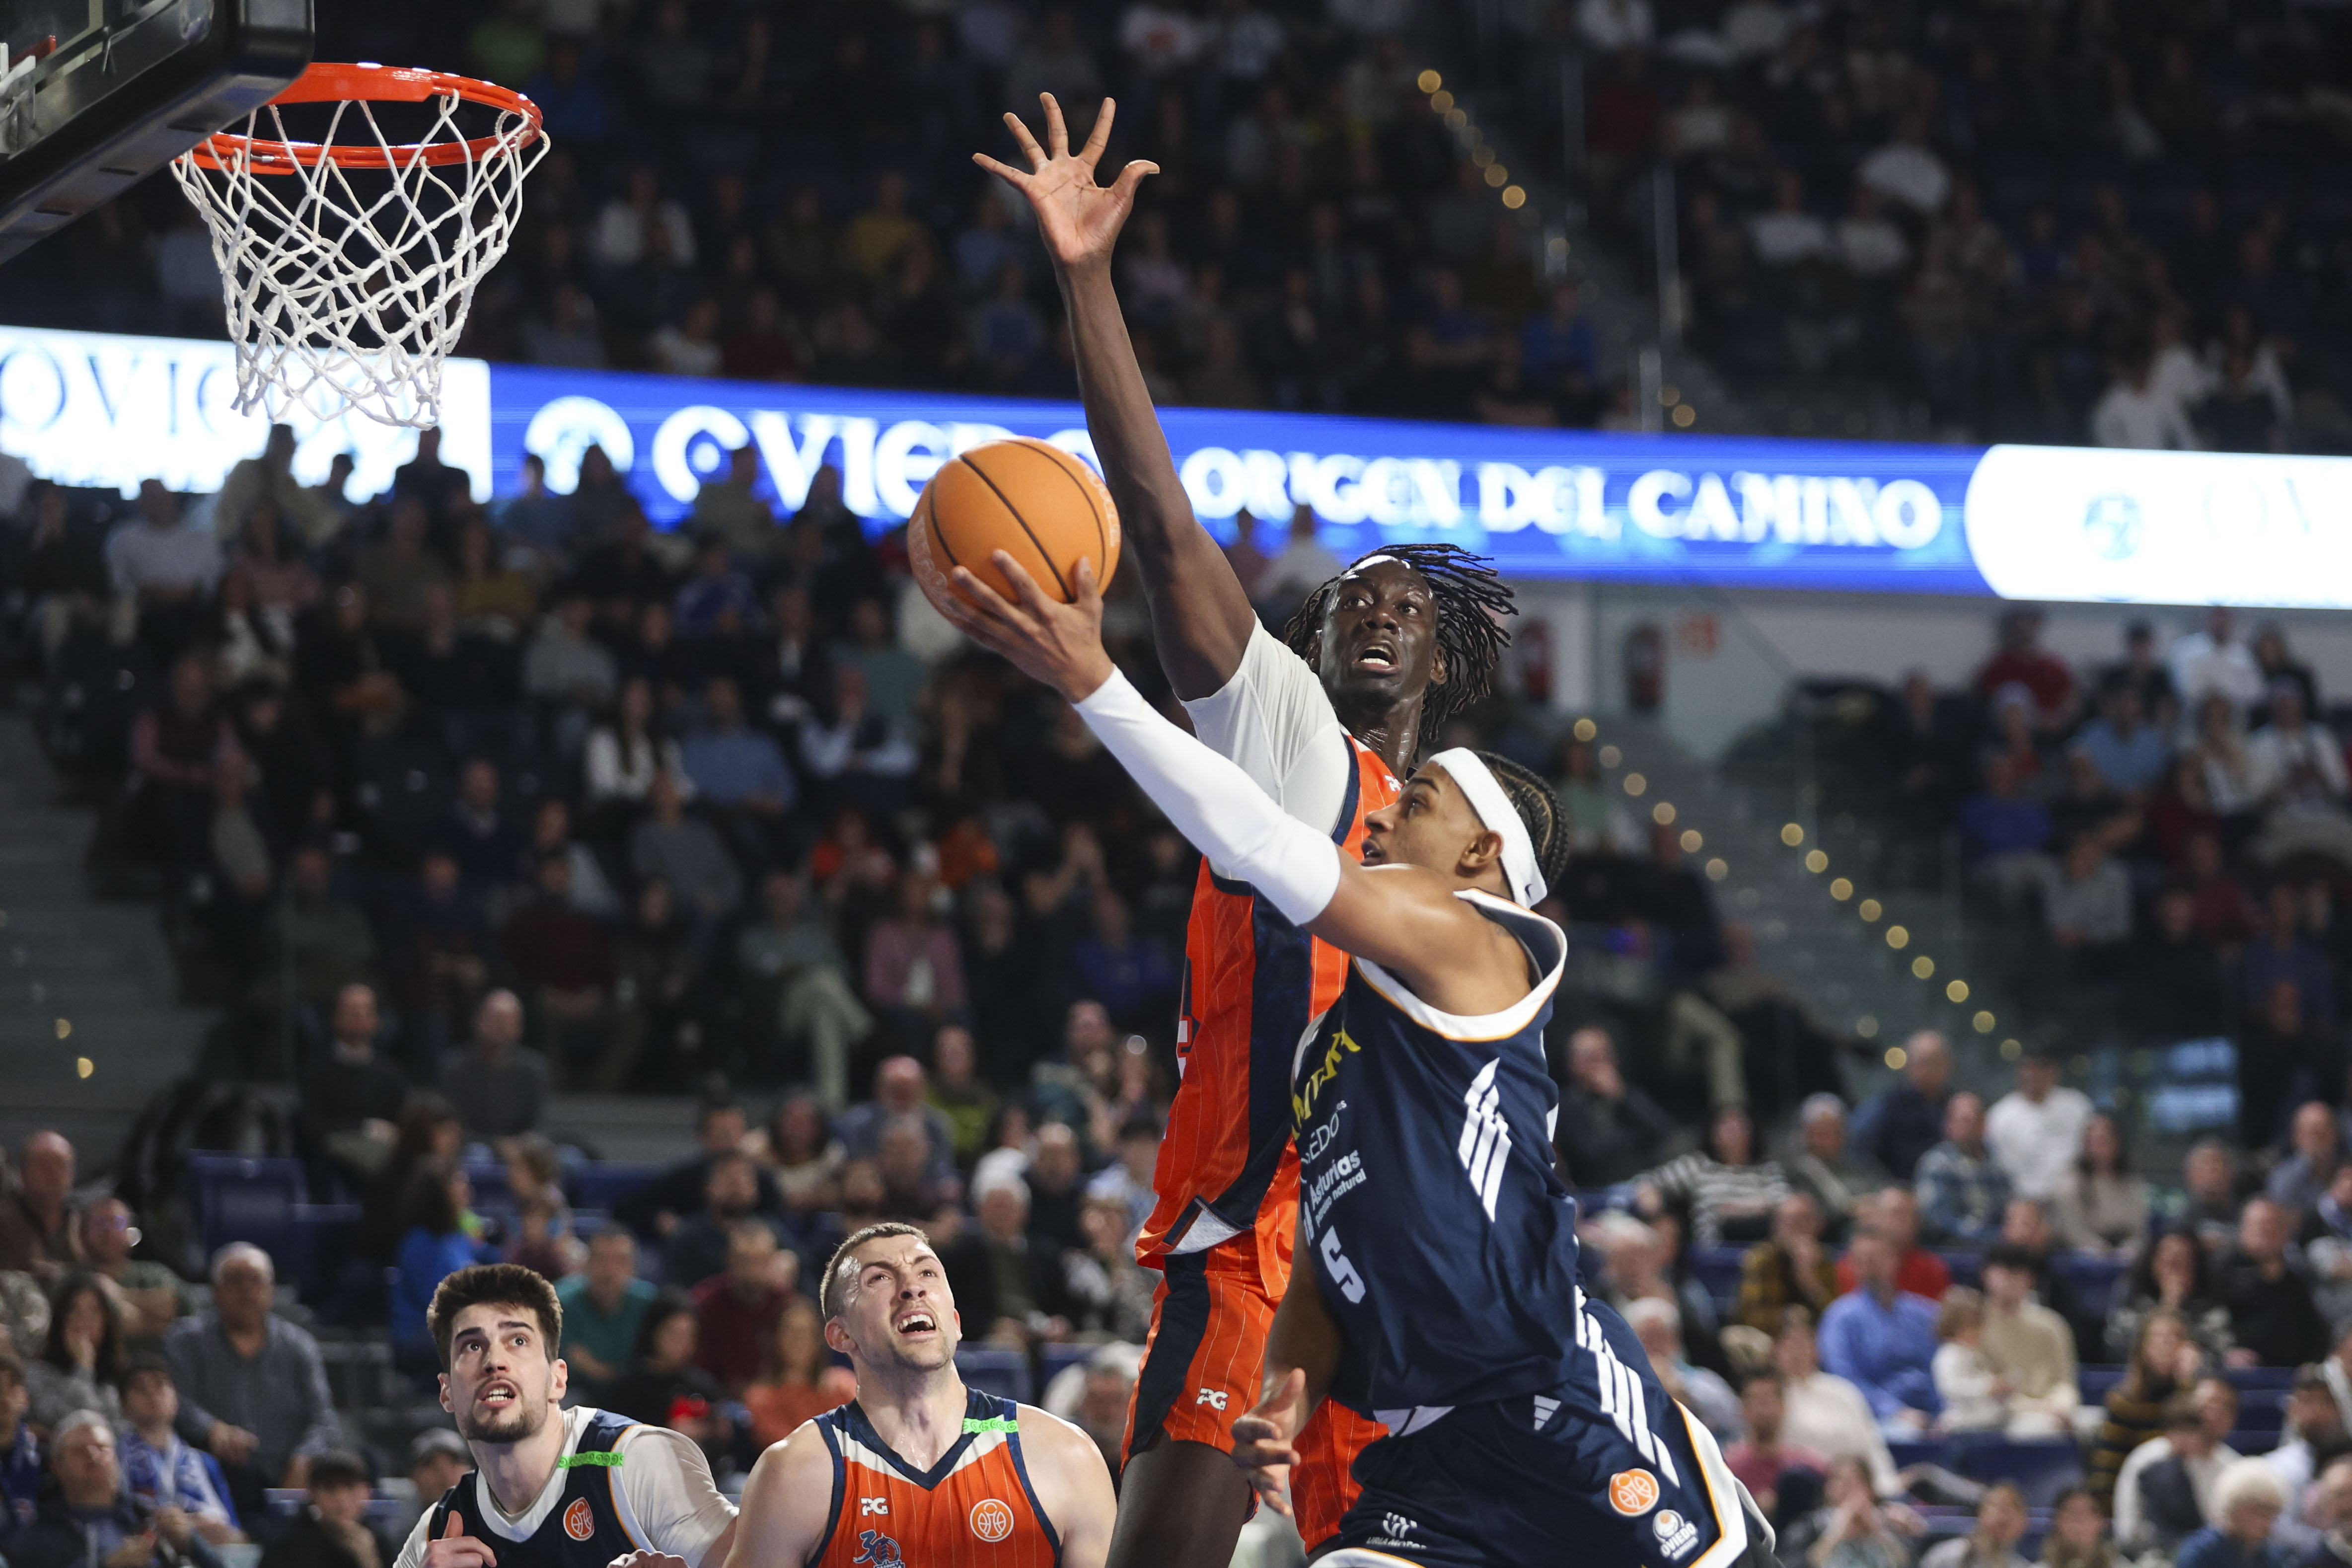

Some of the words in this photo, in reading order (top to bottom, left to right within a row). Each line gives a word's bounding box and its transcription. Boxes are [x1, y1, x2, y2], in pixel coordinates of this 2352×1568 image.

[1627, 468, 1943, 549] CAMINO
[1332, 1168, 1367, 1200] natural
[1320, 1225, 1366, 1304] 5
[1660, 1520, 1697, 1558] OVIEDO
